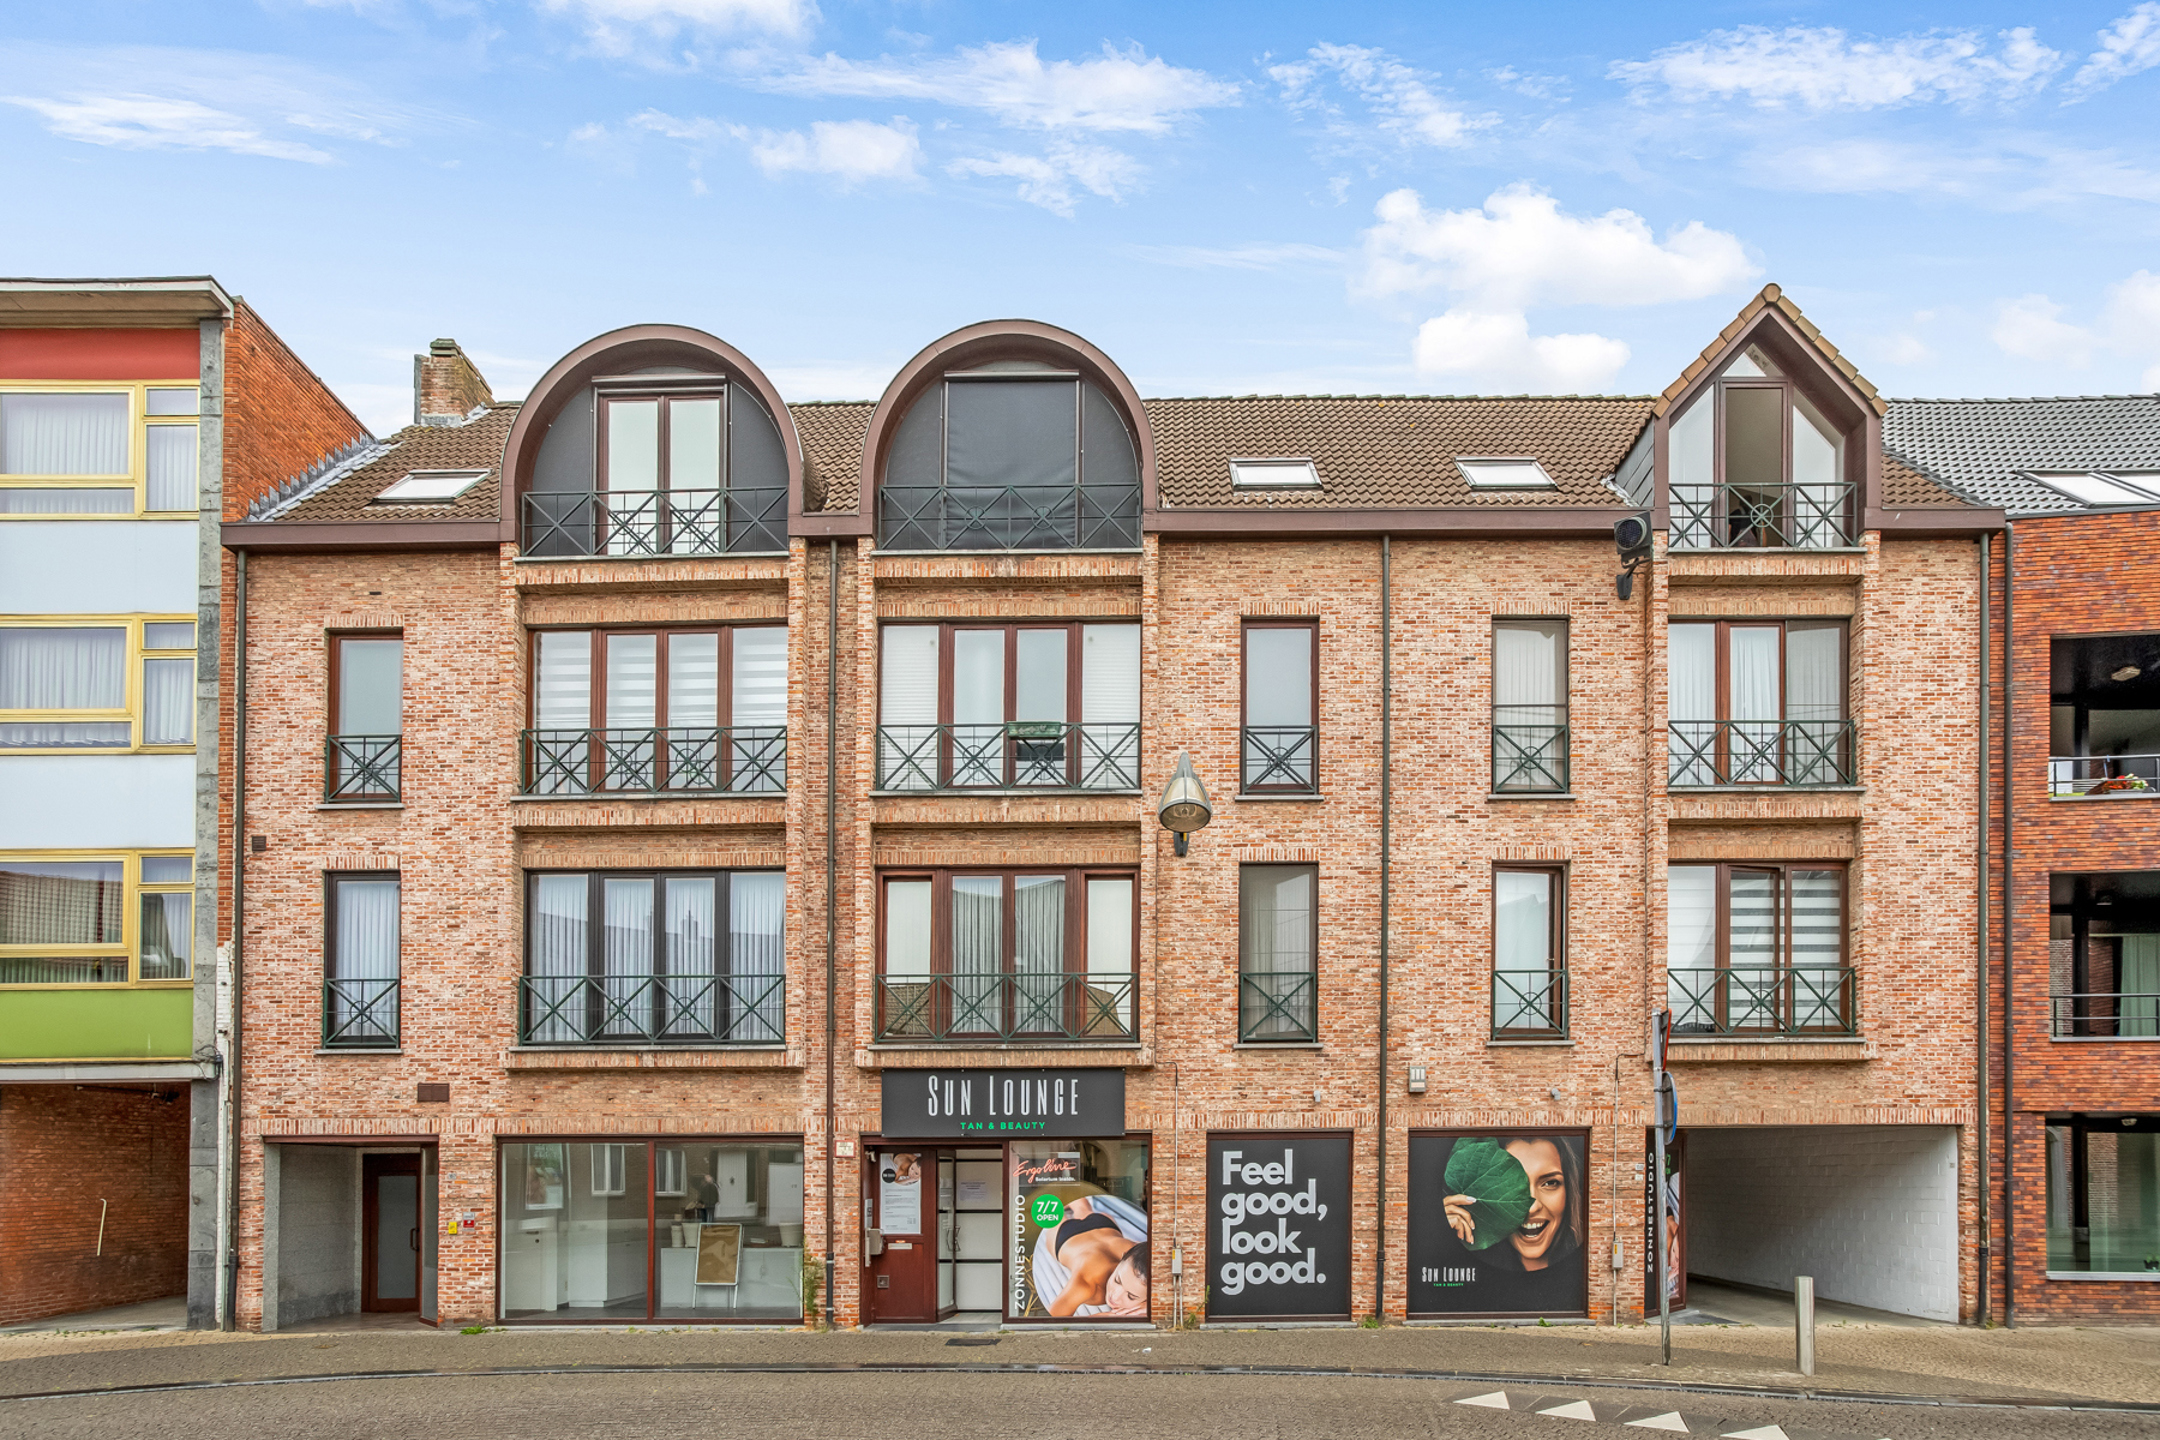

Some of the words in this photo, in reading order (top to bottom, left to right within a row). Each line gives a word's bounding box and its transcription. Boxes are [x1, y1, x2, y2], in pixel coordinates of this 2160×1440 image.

[960, 1121, 983, 1130] TAN
[988, 1121, 995, 1130] &
[1000, 1121, 1046, 1130] BEAUTY
[1012, 1158, 1077, 1184] Ergoline
[1222, 1148, 1293, 1185] Feel
[1036, 1200, 1058, 1214] 7/7
[1221, 1178, 1328, 1226] good,
[1014, 1194, 1026, 1310] ZONNESTUDIO
[1222, 1217, 1302, 1254] look
[1220, 1247, 1327, 1296] good.
